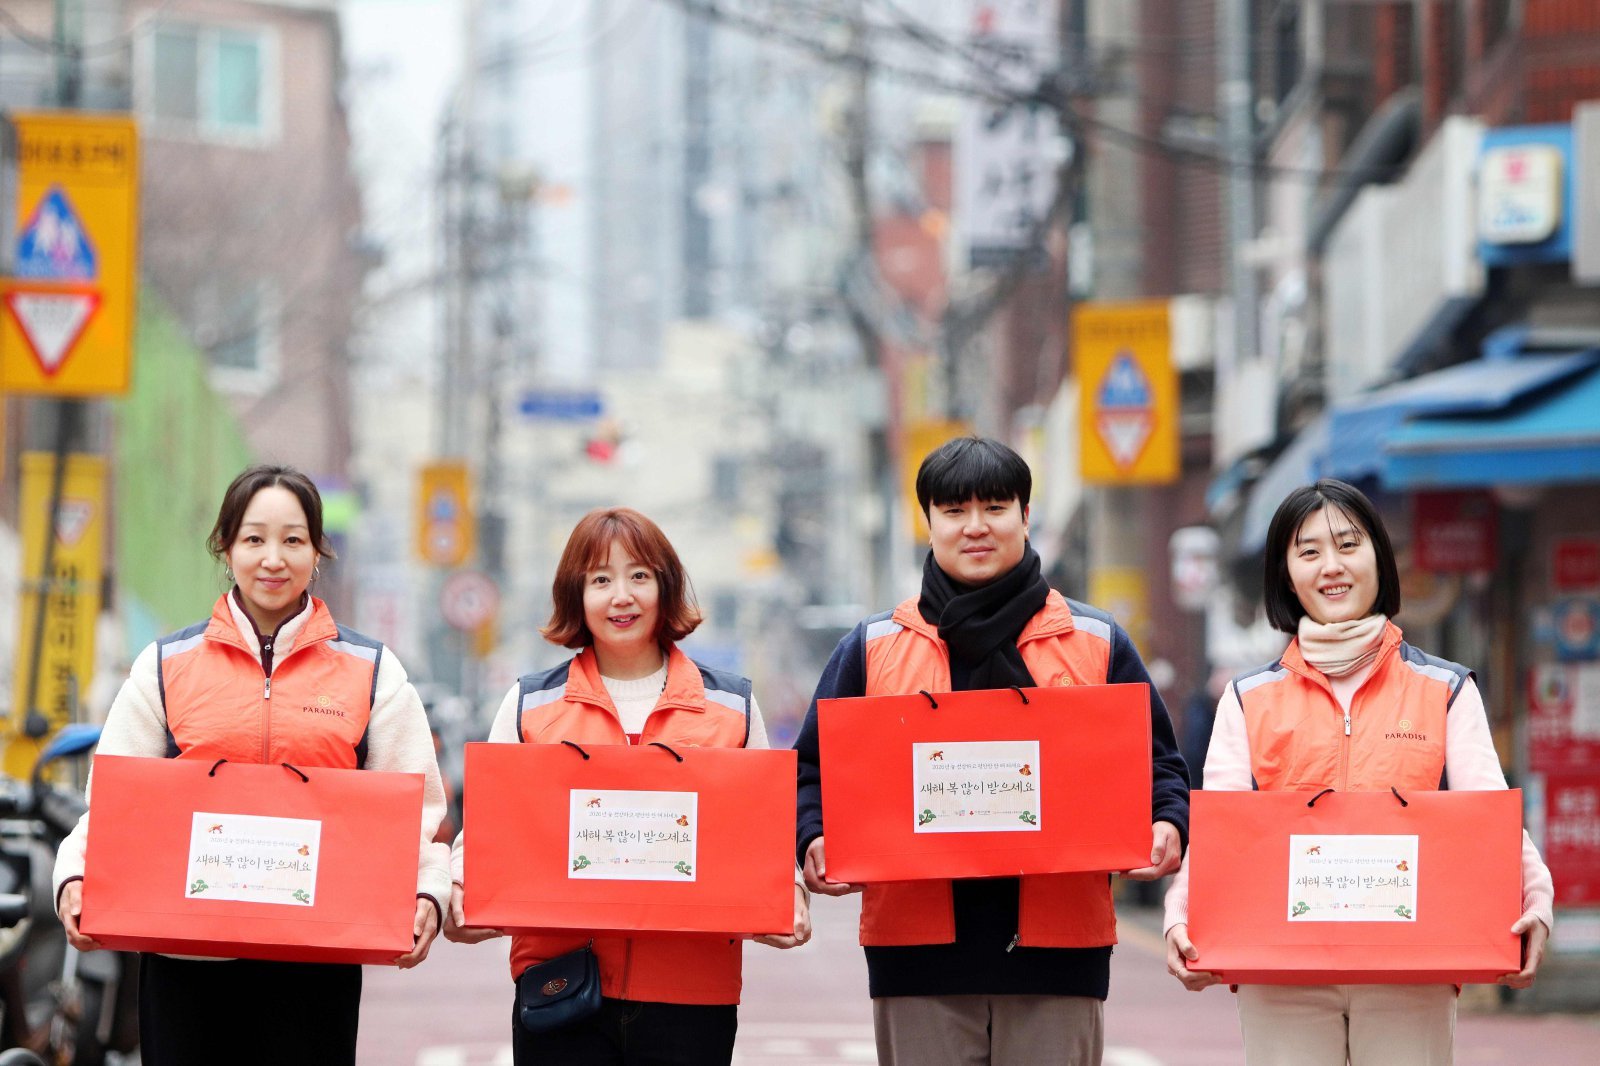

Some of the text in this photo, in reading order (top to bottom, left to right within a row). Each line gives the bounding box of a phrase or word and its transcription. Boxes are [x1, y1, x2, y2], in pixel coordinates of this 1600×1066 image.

[302, 706, 345, 717] PARADISE
[1385, 732, 1427, 741] PARADISE
[920, 780, 1035, 796] 새해 복 많이 받으세요
[576, 829, 692, 844] 새해 복 많이 받으세요
[195, 854, 312, 872] 새해 복 많이 받으세요
[1296, 875, 1412, 889] 새해 복 많이 받으세요
